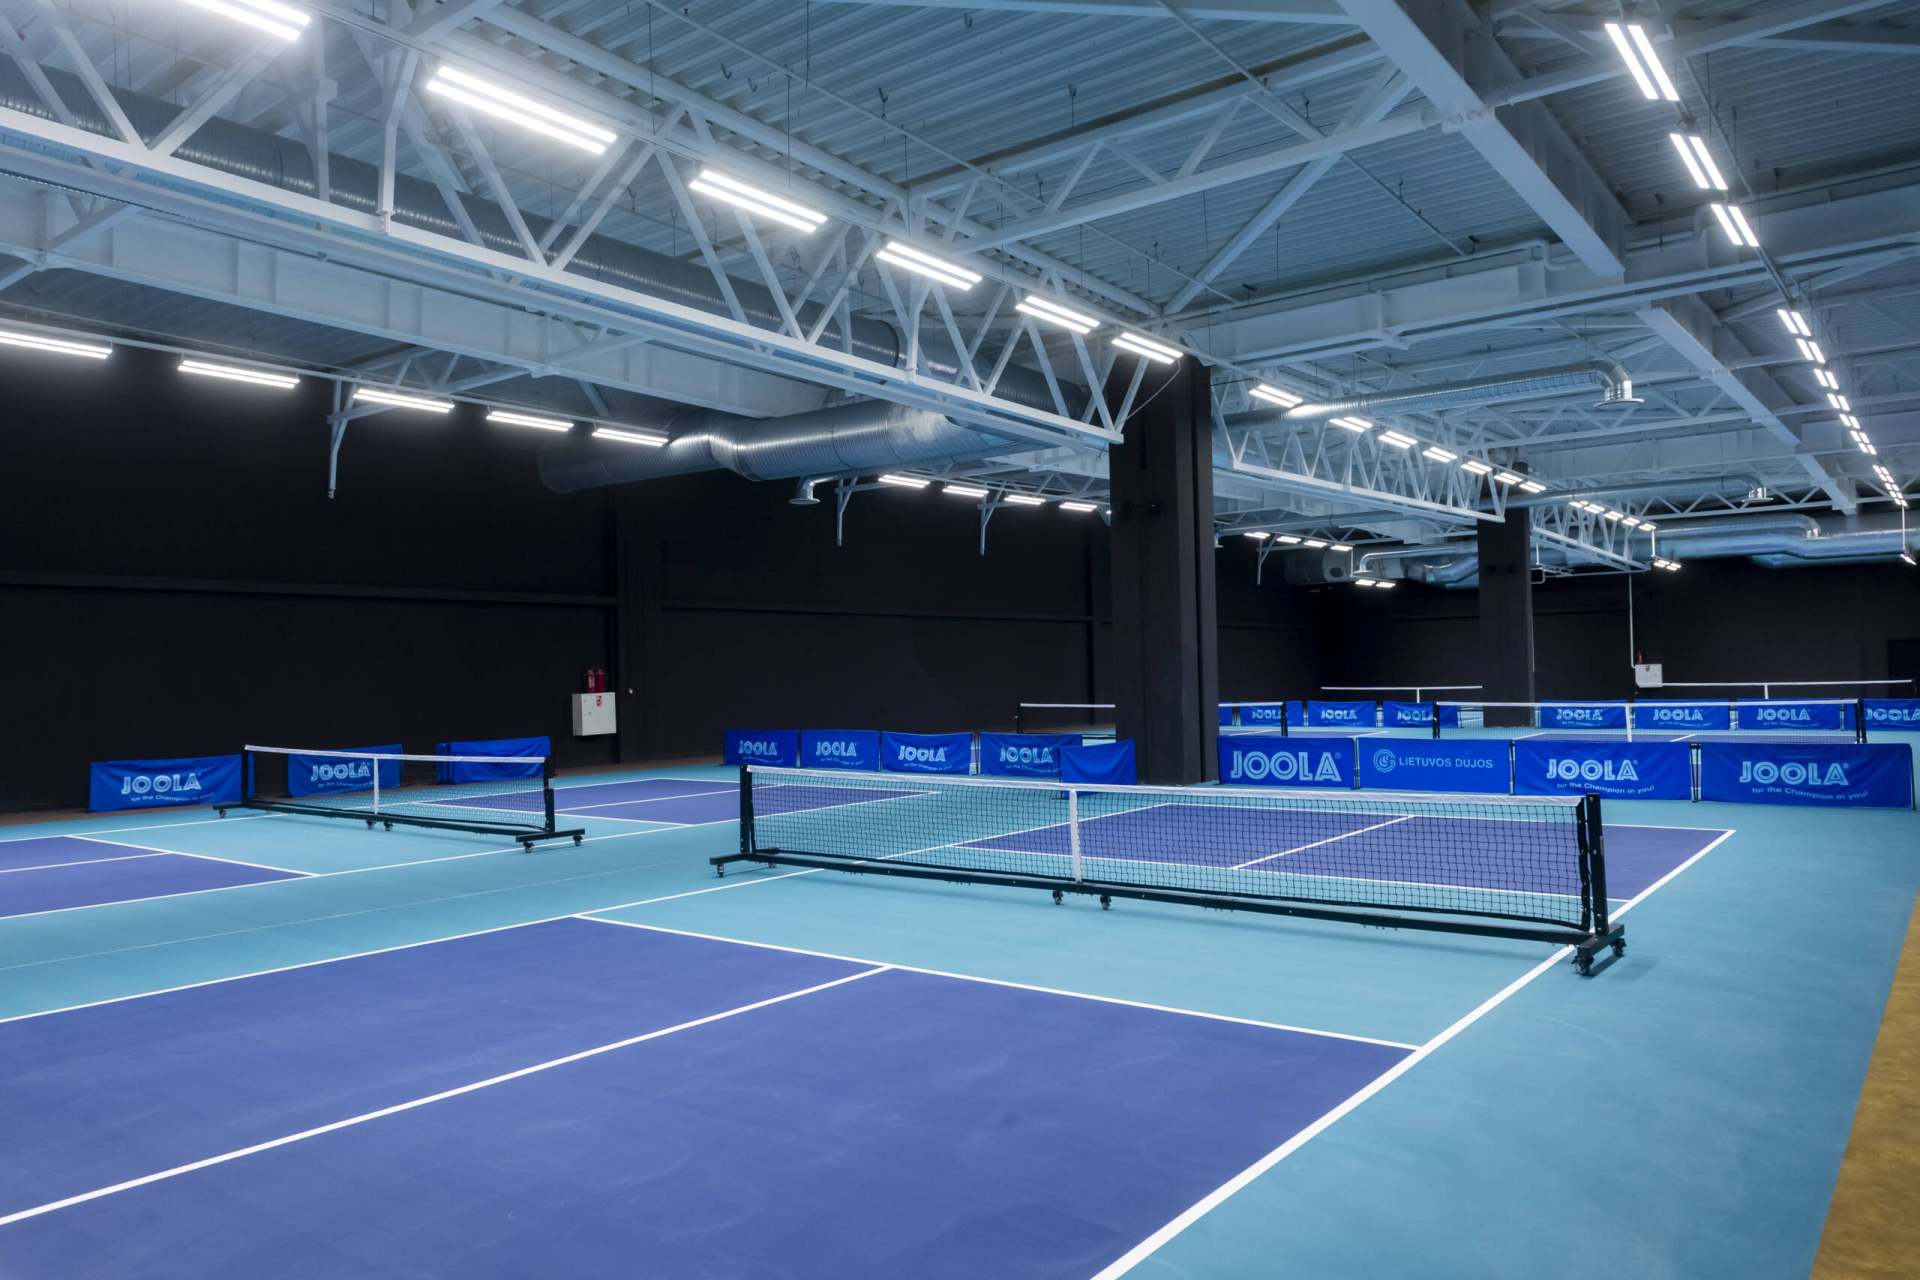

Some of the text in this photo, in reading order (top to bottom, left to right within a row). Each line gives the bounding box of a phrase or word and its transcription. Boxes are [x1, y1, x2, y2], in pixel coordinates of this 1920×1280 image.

[1321, 709, 1357, 720] JOOLA
[1556, 708, 1603, 721] JOOLA
[1653, 709, 1703, 721] JOOLA
[1757, 708, 1811, 721] JOOLA
[738, 740, 778, 756] JOOLA
[816, 742, 857, 757] JOOLA
[898, 745, 946, 762] JOOLA
[999, 746, 1053, 763] JOOLA
[1230, 750, 1342, 782] JOOLA
[1399, 757, 1494, 769] LIETUVOS DUJOS
[1546, 759, 1639, 781] JOOLA
[311, 762, 371, 782] JOOLA
[1739, 761, 1850, 786] JOOLA
[121, 773, 202, 795] JOOLA
[1584, 782, 1625, 794] Champion
[1637, 785, 1655, 794] you!
[1784, 787, 1834, 800] Champion
[1847, 790, 1869, 800] you!
